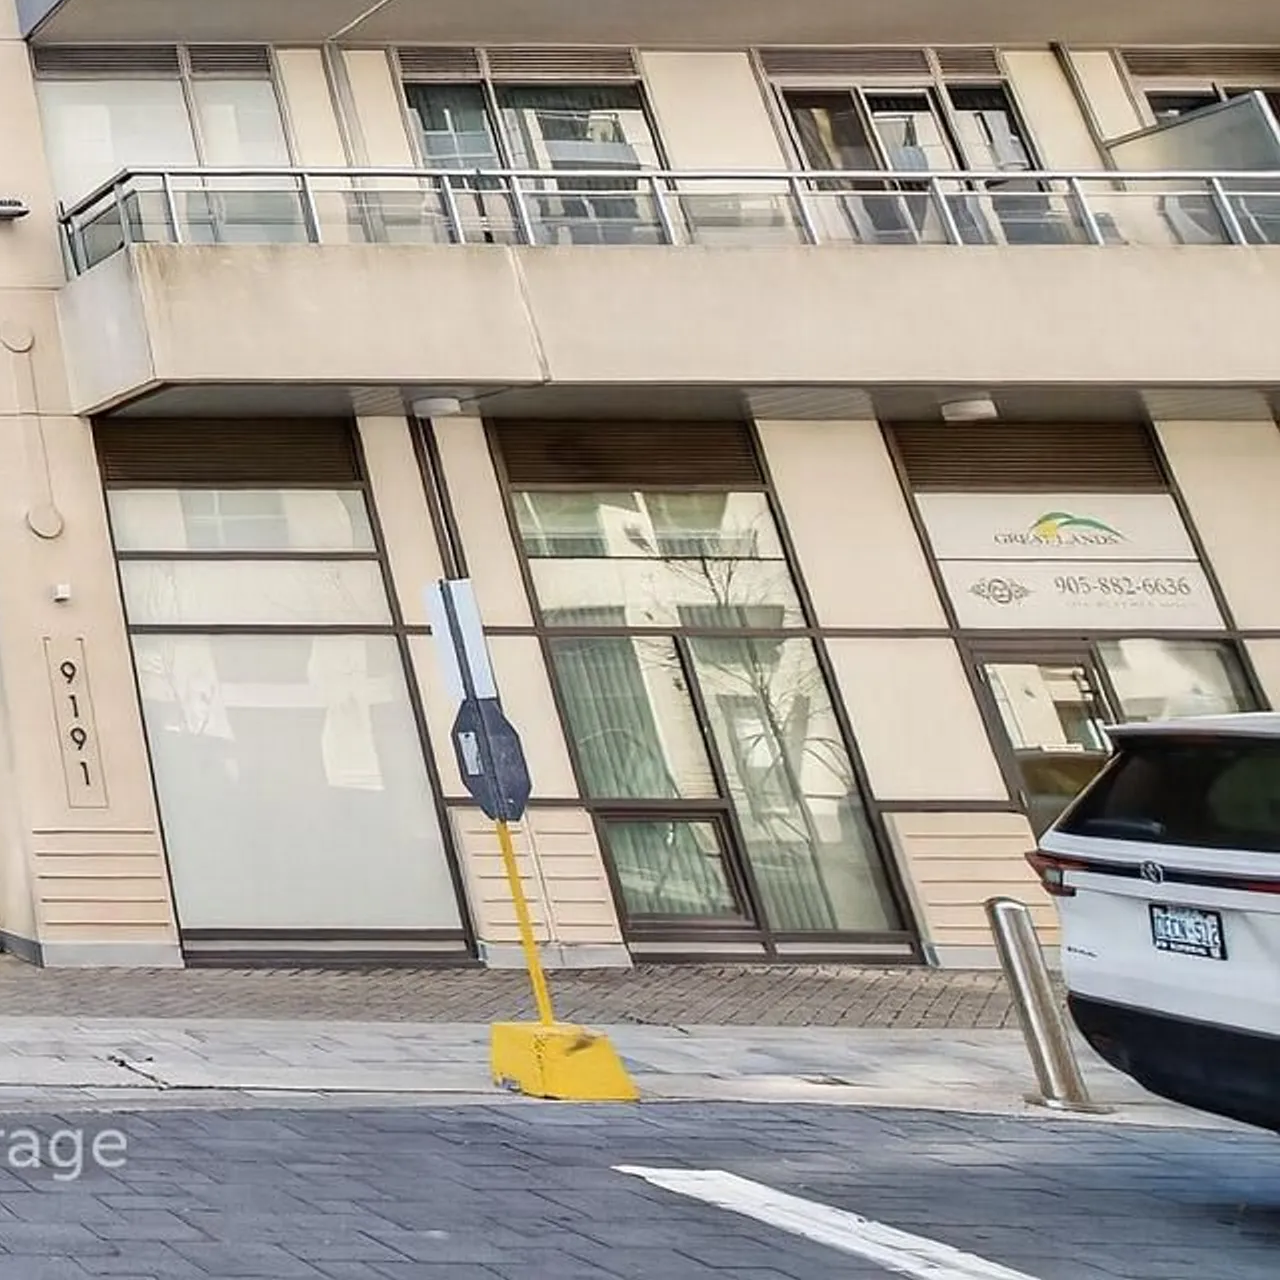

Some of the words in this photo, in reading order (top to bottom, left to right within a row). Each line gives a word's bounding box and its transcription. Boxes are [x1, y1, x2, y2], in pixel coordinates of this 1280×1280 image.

[1055, 533, 1119, 545] LANDS
[1053, 575, 1191, 596] 905-882-6636
[60, 661, 90, 786] 9191
